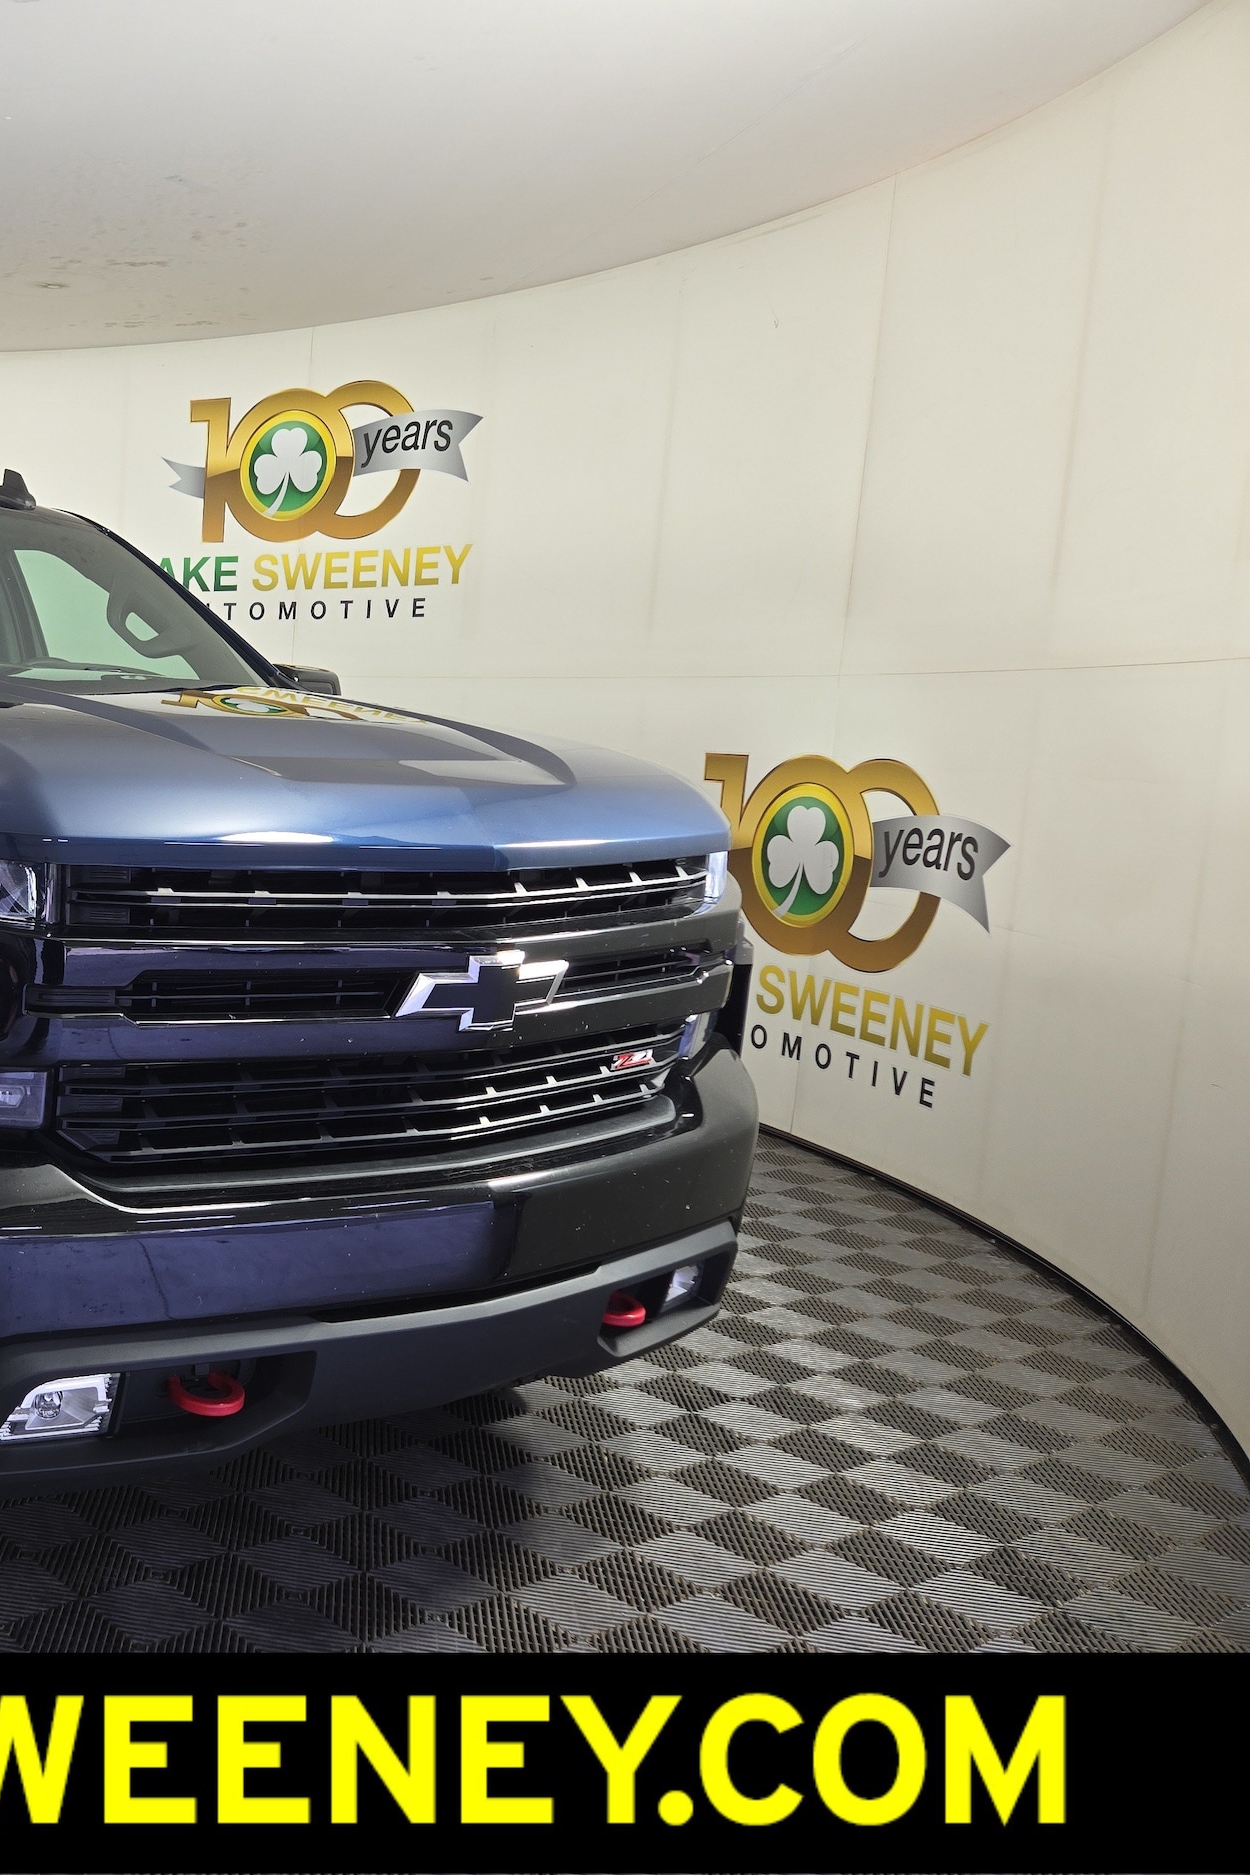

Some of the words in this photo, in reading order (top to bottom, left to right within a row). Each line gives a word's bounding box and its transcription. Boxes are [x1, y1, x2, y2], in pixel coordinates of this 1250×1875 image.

[190, 380, 421, 543] 100
[361, 417, 453, 468] years
[158, 555, 239, 592] AKE
[252, 543, 473, 592] SWEENEY
[206, 597, 426, 621] TOMOTIVE
[878, 826, 979, 881] years
[756, 964, 989, 1077] SWEENEY
[610, 1048, 654, 1071] Z71
[750, 1024, 936, 1109] OMOTIVE
